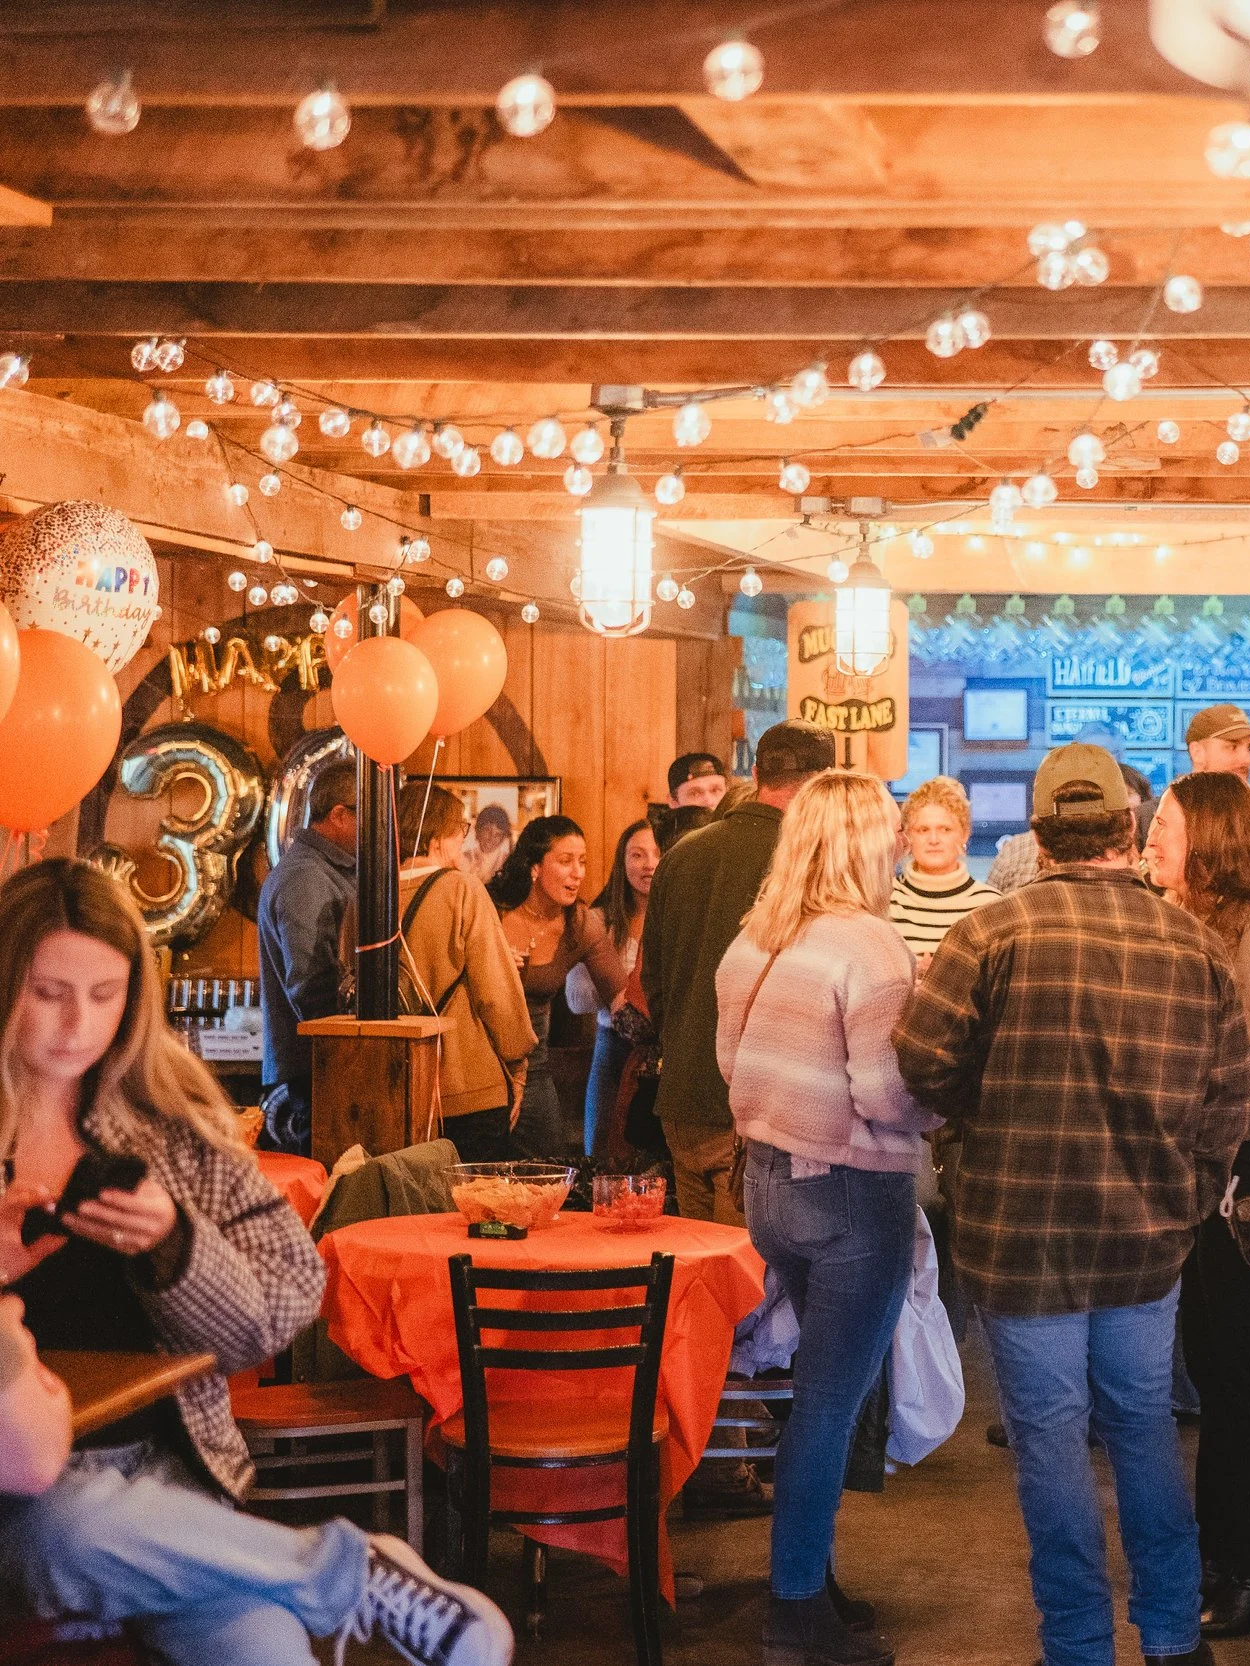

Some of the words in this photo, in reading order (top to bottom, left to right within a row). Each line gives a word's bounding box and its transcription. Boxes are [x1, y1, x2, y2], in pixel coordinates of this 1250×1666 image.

[53, 586, 152, 630] Birthday
[168, 635, 329, 697] HAPP
[805, 700, 848, 730] FAST
[851, 700, 892, 729] LANE
